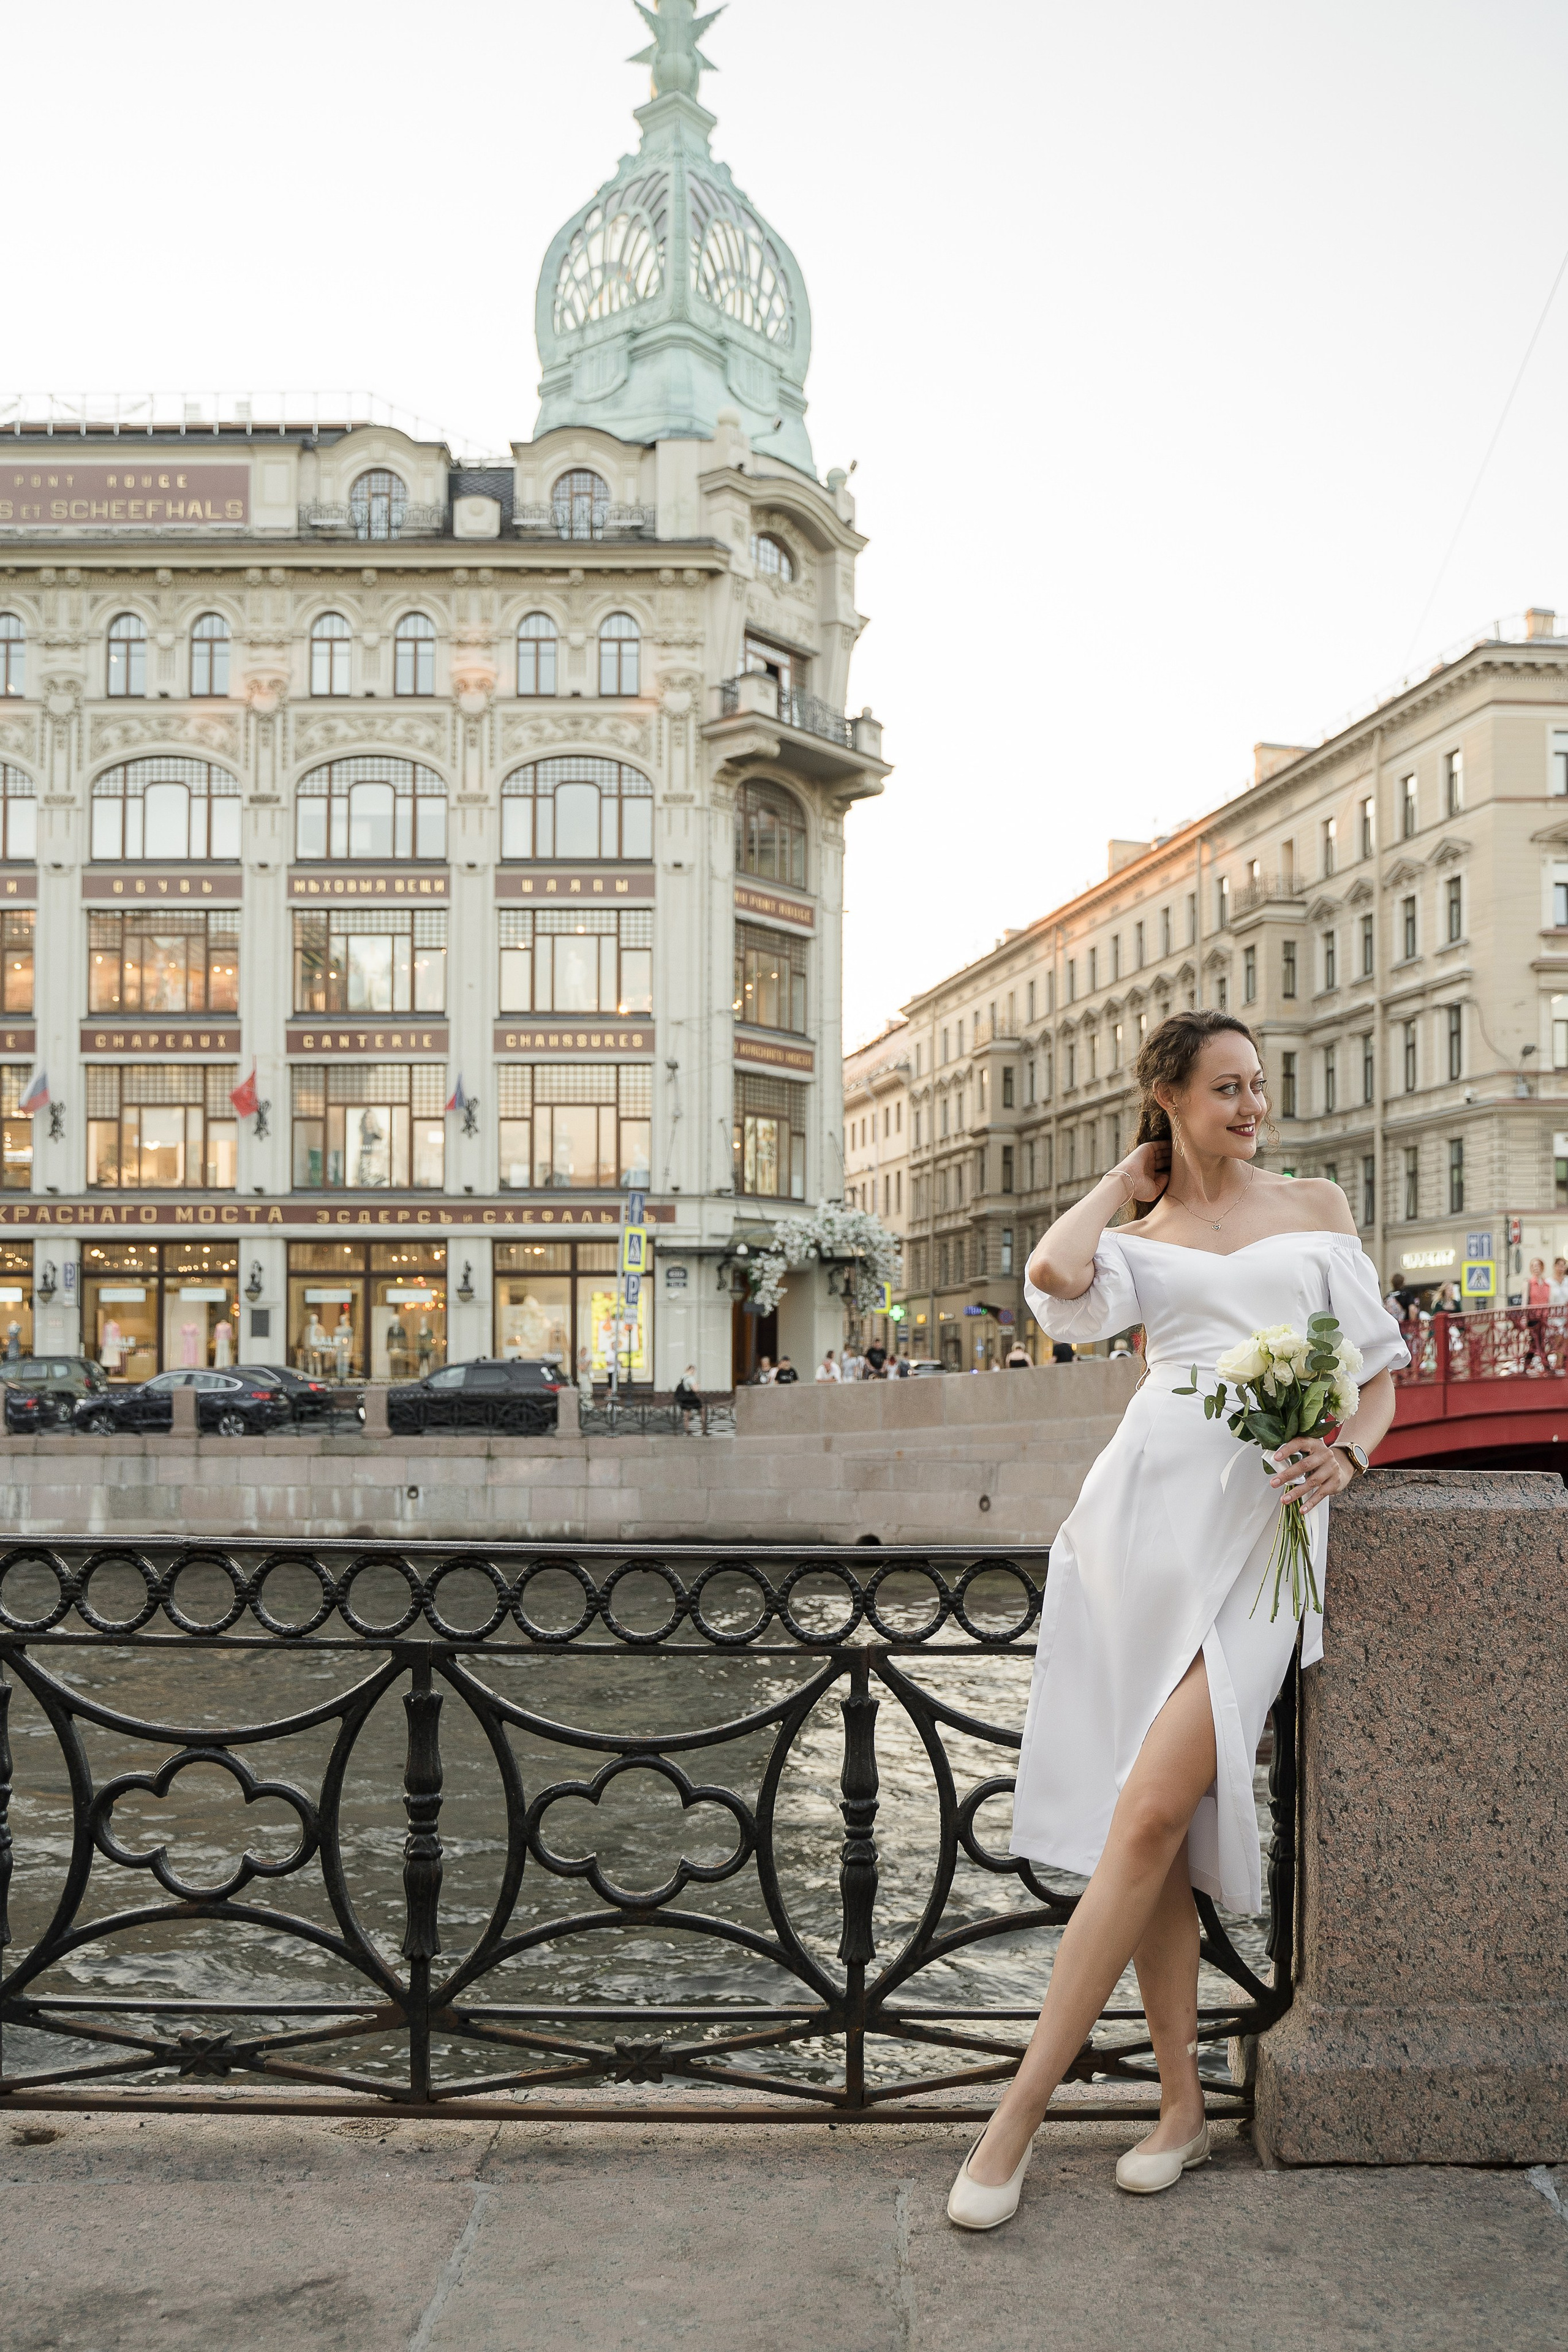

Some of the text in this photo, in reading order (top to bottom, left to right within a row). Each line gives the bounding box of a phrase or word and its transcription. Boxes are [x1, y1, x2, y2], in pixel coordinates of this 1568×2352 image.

[13, 473, 188, 488] PONT ROUGE
[50, 499, 244, 520] SCHEEFHALS
[113, 879, 213, 894] ОБУВЬ
[394, 878, 445, 894] ВЕЩИ
[521, 878, 628, 893] ШЛЯПЫ
[94, 1034, 227, 1048] CHAPEAUX
[505, 1033, 643, 1048] CHAUSSURES
[175, 1205, 284, 1224] МОСТА
[315, 1210, 453, 1224] ЭСДЕРСЪ
[483, 1210, 656, 1224] СХЕФАЛЬЪ
